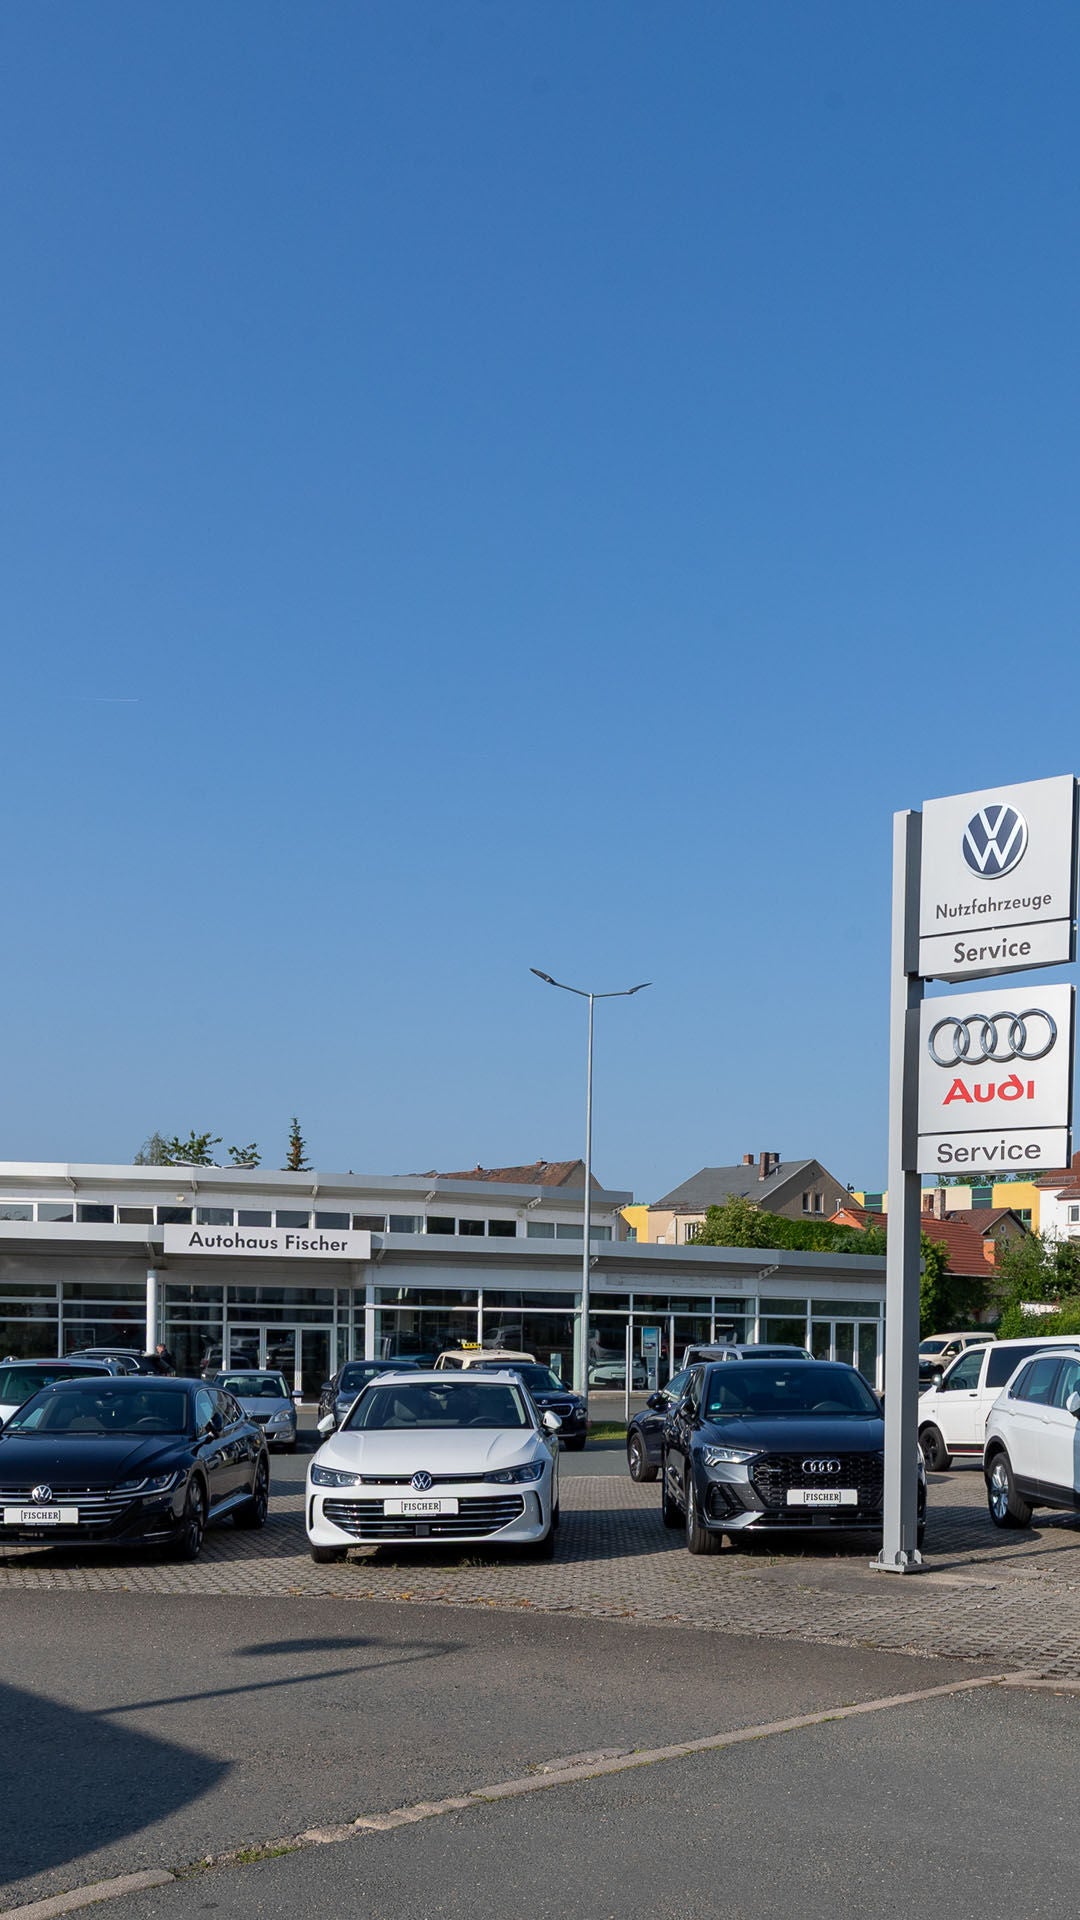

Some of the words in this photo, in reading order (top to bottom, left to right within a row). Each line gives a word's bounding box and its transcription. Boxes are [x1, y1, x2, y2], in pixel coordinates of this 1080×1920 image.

[936, 894, 1052, 920] Nutzfahrzeuge
[953, 937, 1031, 964] Service
[942, 1074, 1035, 1105] Audi
[937, 1140, 1041, 1164] Service
[188, 1231, 278, 1249] Autohaus
[285, 1235, 348, 1251] Fischer
